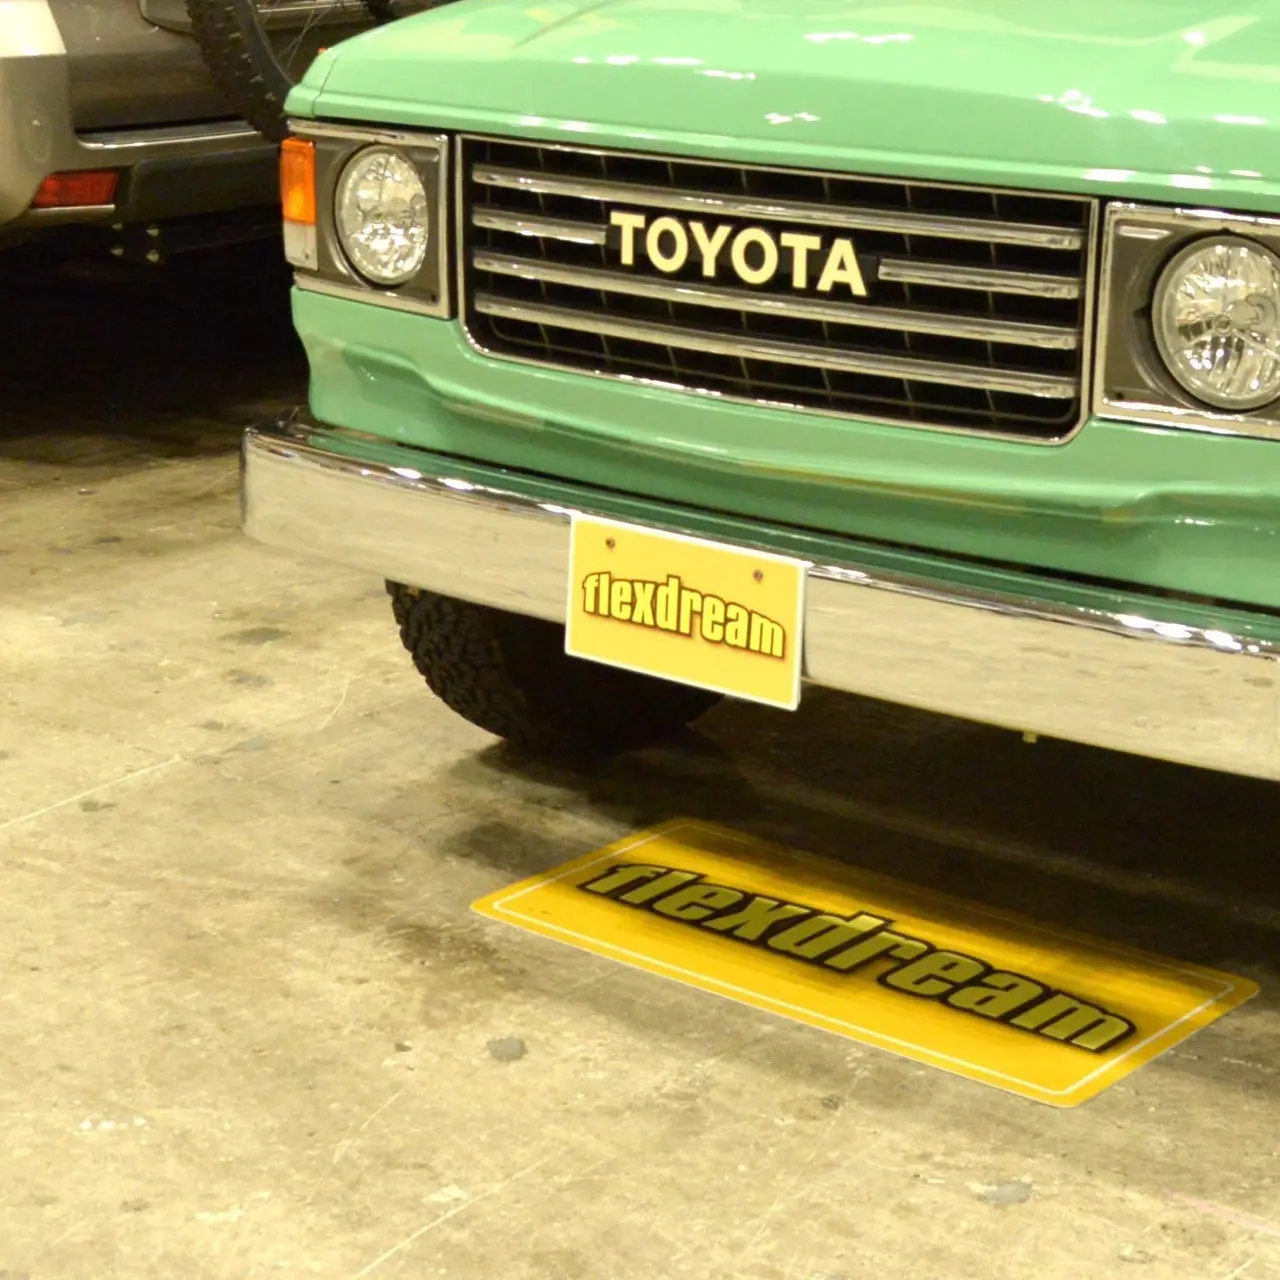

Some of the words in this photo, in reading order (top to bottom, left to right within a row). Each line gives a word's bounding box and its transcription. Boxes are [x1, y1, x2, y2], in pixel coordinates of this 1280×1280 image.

[608, 210, 869, 298] TOYOTA
[580, 570, 786, 661] flexdream
[575, 862, 1140, 1057] flexdream
